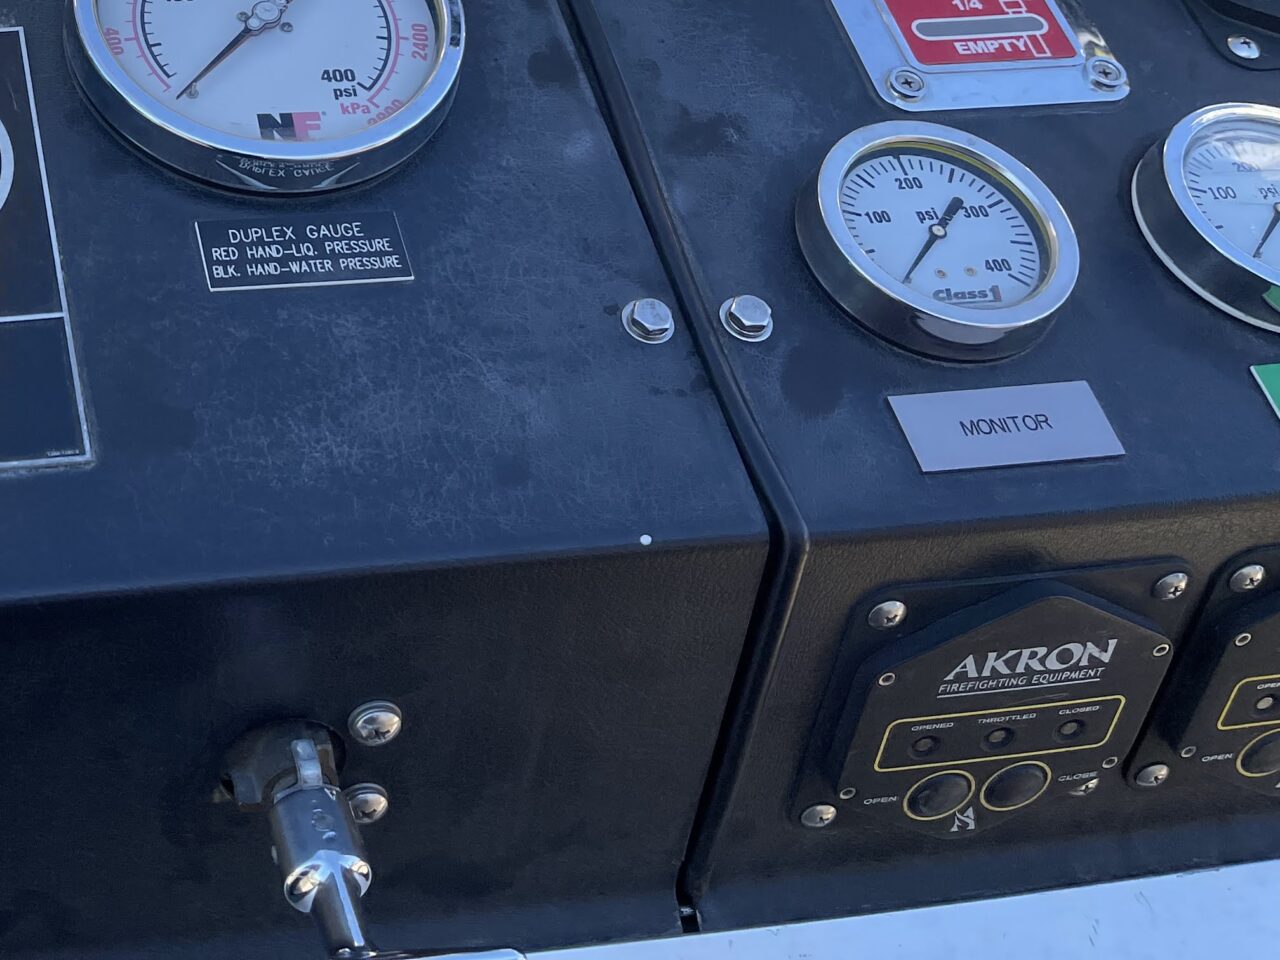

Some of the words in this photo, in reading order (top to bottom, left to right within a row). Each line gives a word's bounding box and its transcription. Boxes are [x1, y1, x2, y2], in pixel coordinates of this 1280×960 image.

[953, 39, 1027, 56] EMPTY
[321, 69, 356, 82] 400
[333, 85, 357, 100] psi
[340, 102, 371, 115] kPa
[894, 176, 923, 190] 200
[1208, 186, 1237, 199] 100
[864, 210, 892, 224] 100
[915, 207, 940, 223] psi
[963, 205, 990, 218] 300
[228, 226, 296, 243] DUPLEX
[306, 222, 364, 239] GAUGE
[212, 247, 238, 260] RED
[246, 243, 318, 259] HAND-LIQ.
[324, 238, 393, 254] PRESSURE
[213, 265, 241, 278] BLK.
[247, 259, 333, 276] HAND-WATER
[340, 255, 402, 271] PRESSURE
[985, 259, 1012, 272] 400
[959, 413, 1053, 437] MONITOR
[944, 639, 1118, 680] AKRON
[938, 675, 1027, 694] FIREFIGHTING
[1032, 667, 1106, 683] EQUIPMENT
[911, 722, 954, 731] OPENED
[978, 713, 1037, 724] THROTTLED
[1059, 705, 1100, 715] CLOSED
[863, 796, 897, 805] OPEN
[1058, 771, 1098, 782] CLOSE
